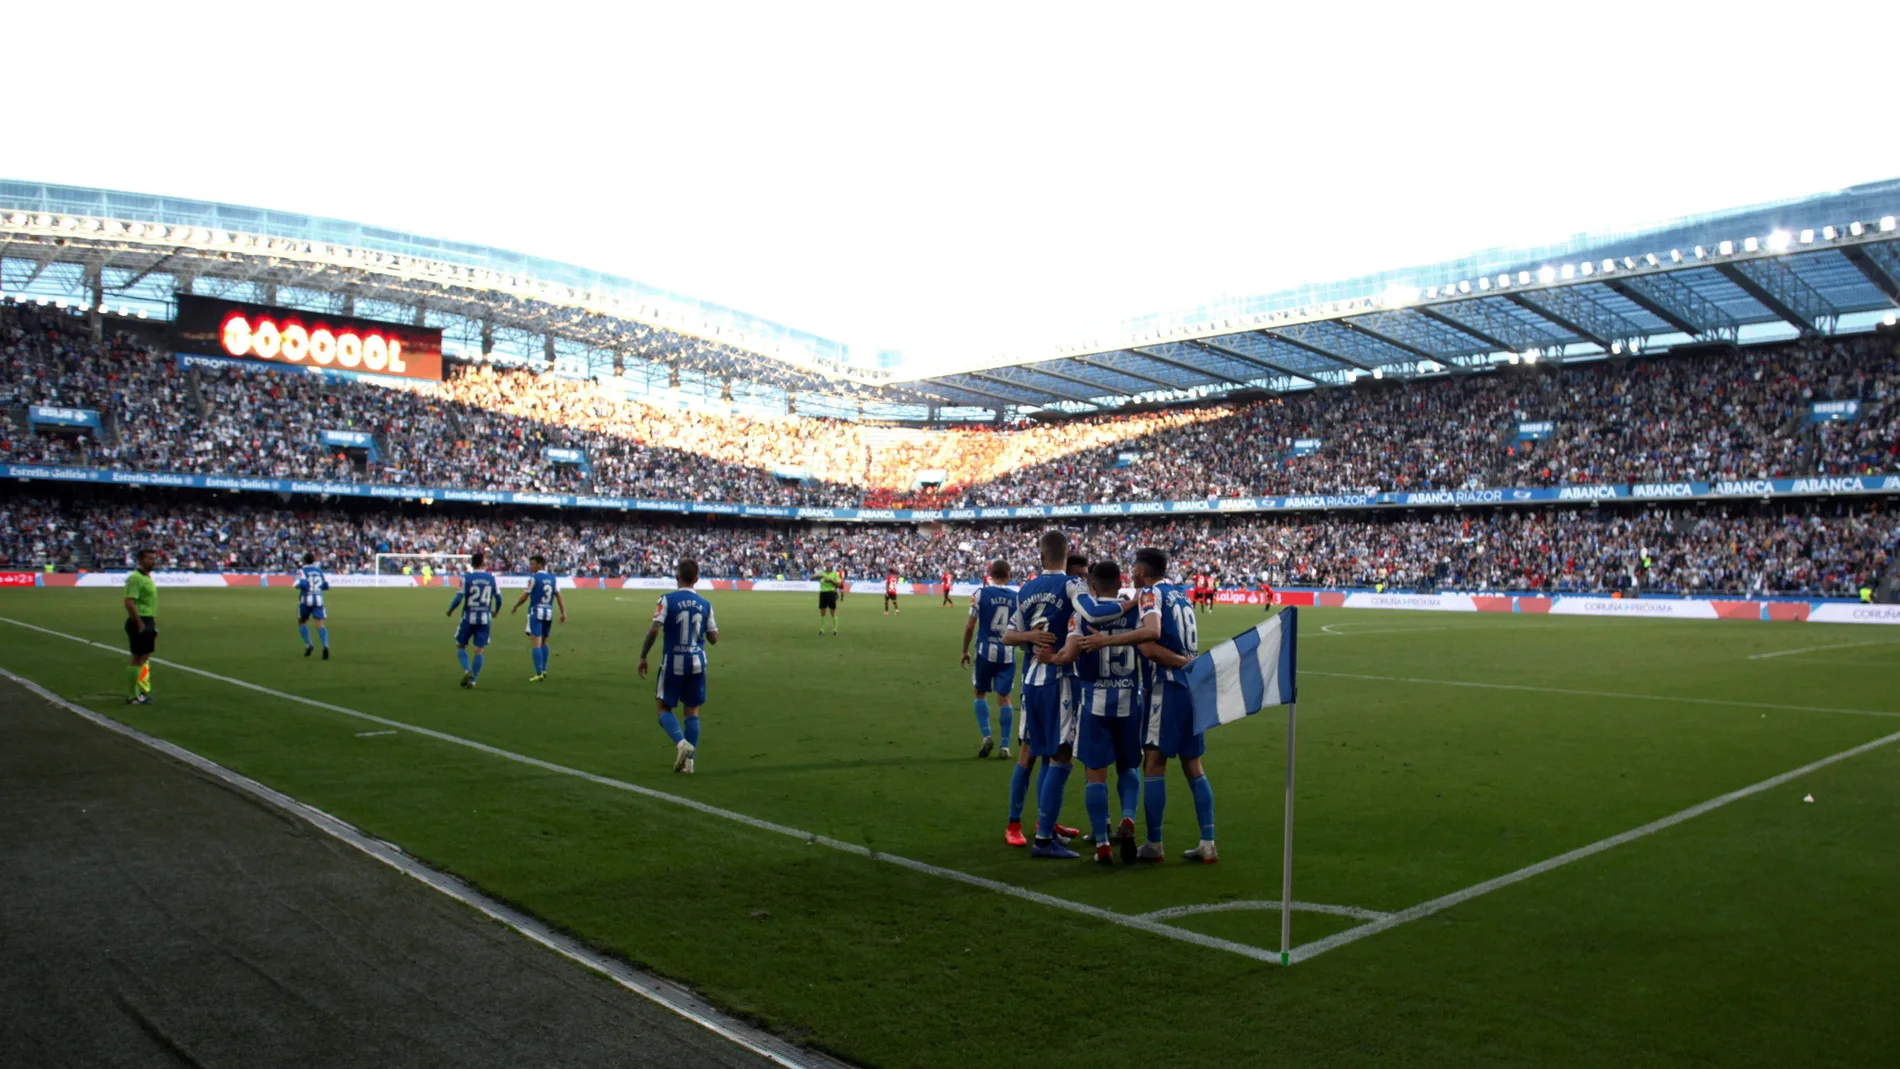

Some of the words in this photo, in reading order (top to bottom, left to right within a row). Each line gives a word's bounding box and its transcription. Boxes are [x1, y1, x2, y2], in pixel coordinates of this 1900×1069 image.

[9, 467, 51, 478] Estrella
[51, 468, 86, 479] Galicia
[112, 472, 148, 483] Estrella
[150, 474, 182, 484] Galicia
[206, 477, 239, 487] Estrella
[240, 478, 270, 489] Galicia
[291, 482, 322, 492] Estrella
[323, 484, 351, 494] Galicia
[1716, 480, 1775, 494] ABANCA
[1796, 477, 1864, 492] ABANCA
[370, 487, 399, 496] Estrella
[400, 488, 426, 498] Galicia
[444, 490, 471, 500] Estrella
[472, 492, 496, 501] Galicia
[1563, 486, 1617, 500] ABANCA
[1635, 484, 1693, 497] ABANCA
[1286, 496, 1325, 507] ABANCA
[1327, 495, 1367, 506] RIAZOR
[1410, 492, 1455, 504] ABANCA
[1456, 490, 1502, 502] RIAZOR
[1091, 504, 1123, 514] ABANCA
[1131, 502, 1165, 512] ABANCA
[1174, 500, 1210, 510] ABANCA
[1220, 498, 1257, 509] ABANCA
[799, 508, 834, 518] ABANCA
[859, 509, 895, 519] ABANCA
[913, 510, 943, 519] ABANCA
[951, 510, 976, 518] ABANCA
[982, 508, 1009, 517] ABANCA
[1017, 507, 1045, 516] ABANCA
[1053, 506, 1083, 515] ABANCA
[307, 576, 323, 592] 12
[468, 584, 493, 606] 24
[541, 584, 553, 604] 3
[1216, 591, 1246, 604] LaLiga
[1584, 602, 1624, 612] CORUÑA
[676, 610, 703, 646] 11
[990, 606, 1010, 639] 4
[1173, 604, 1198, 654] 18
[1099, 628, 1136, 678] 15
[1093, 679, 1135, 688] ABANCA
